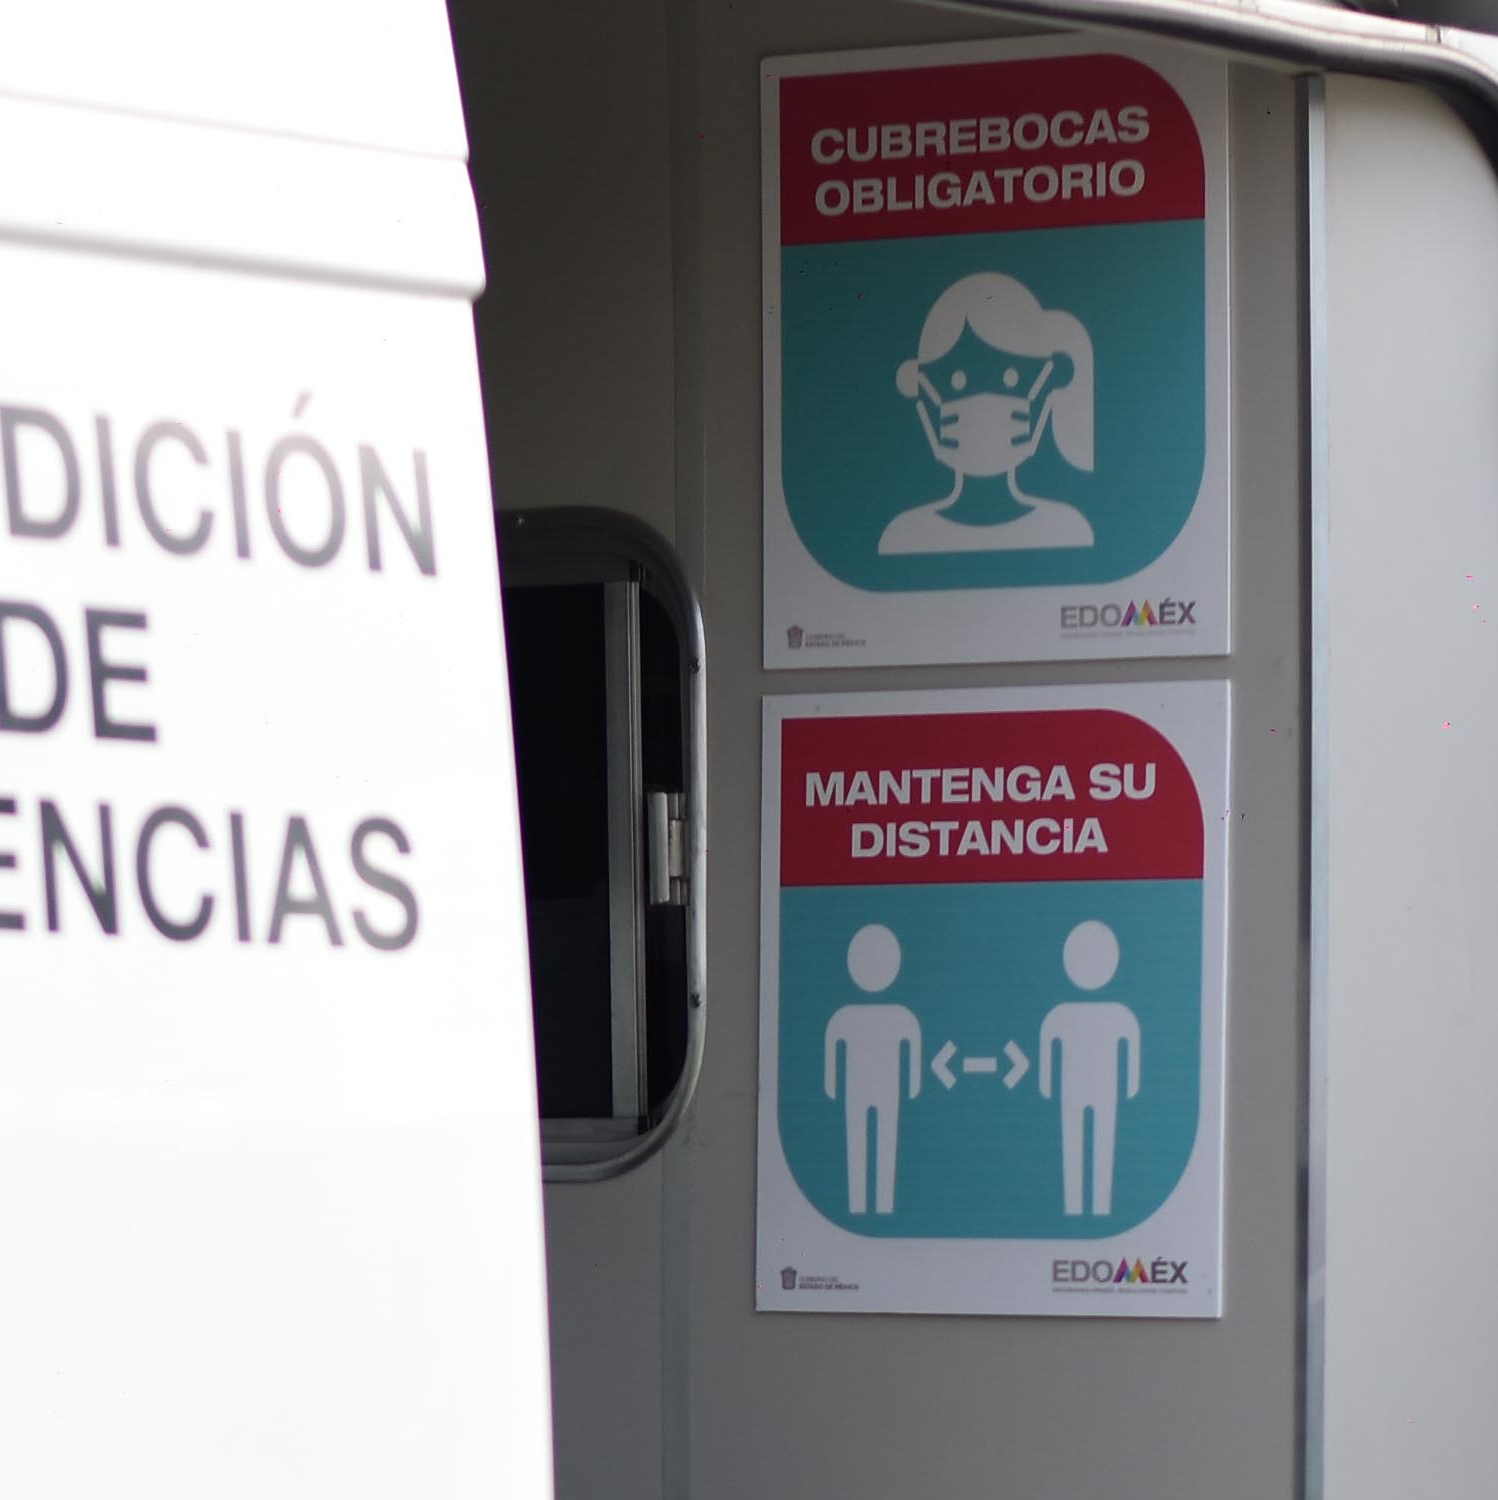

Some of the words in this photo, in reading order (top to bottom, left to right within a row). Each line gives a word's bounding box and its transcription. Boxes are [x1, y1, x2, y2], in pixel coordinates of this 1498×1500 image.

[810, 105, 1151, 165] CUBREBOCAS
[814, 159, 1147, 217] OBLIGATORIO
[1060, 597, 1197, 629] EDOMÉX
[805, 765, 1077, 808] MANTENGA
[1088, 762, 1157, 801] SU
[850, 817, 1110, 859] DISTANCIA
[1051, 1256, 1189, 1284] EDOMÉX
